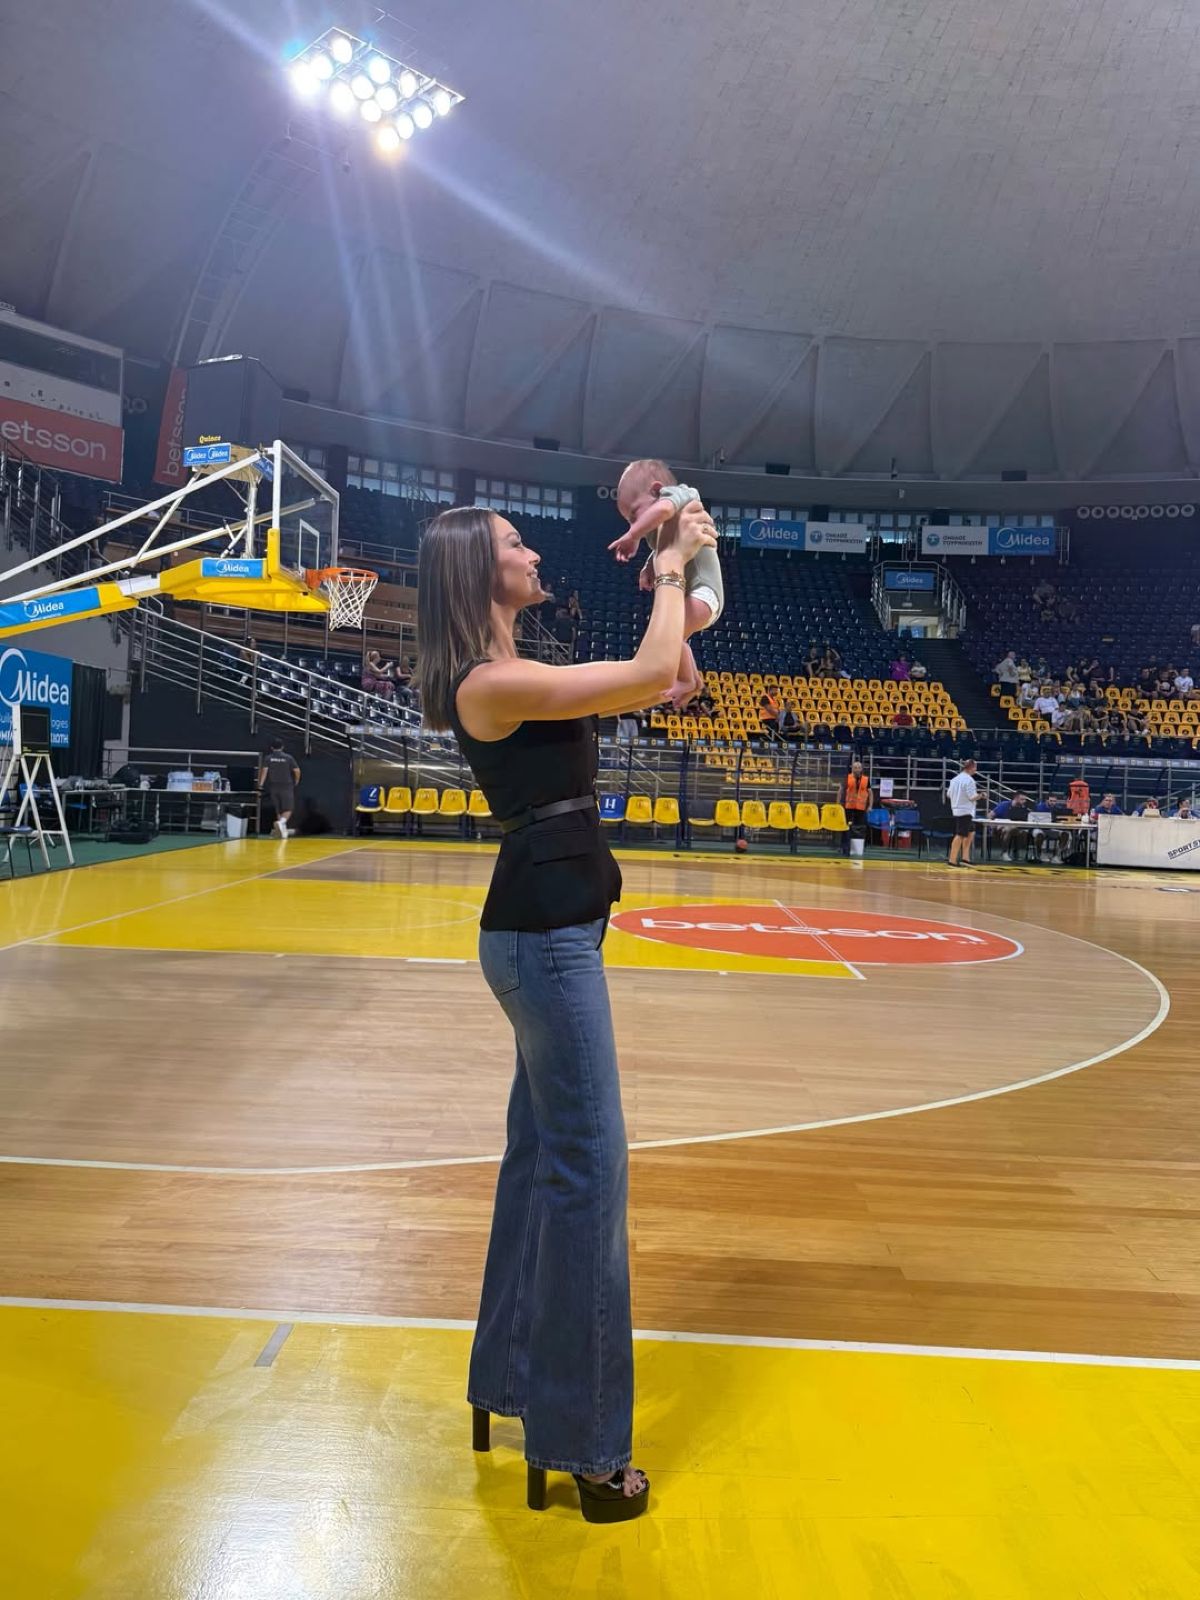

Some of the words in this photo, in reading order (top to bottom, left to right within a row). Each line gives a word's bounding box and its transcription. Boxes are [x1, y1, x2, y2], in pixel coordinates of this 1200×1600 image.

[996, 527, 1050, 548] Midea
[216, 560, 249, 573] Midea
[24, 600, 64, 618] Midea
[0, 648, 69, 708] Midea
[640, 918, 986, 942] betsson
